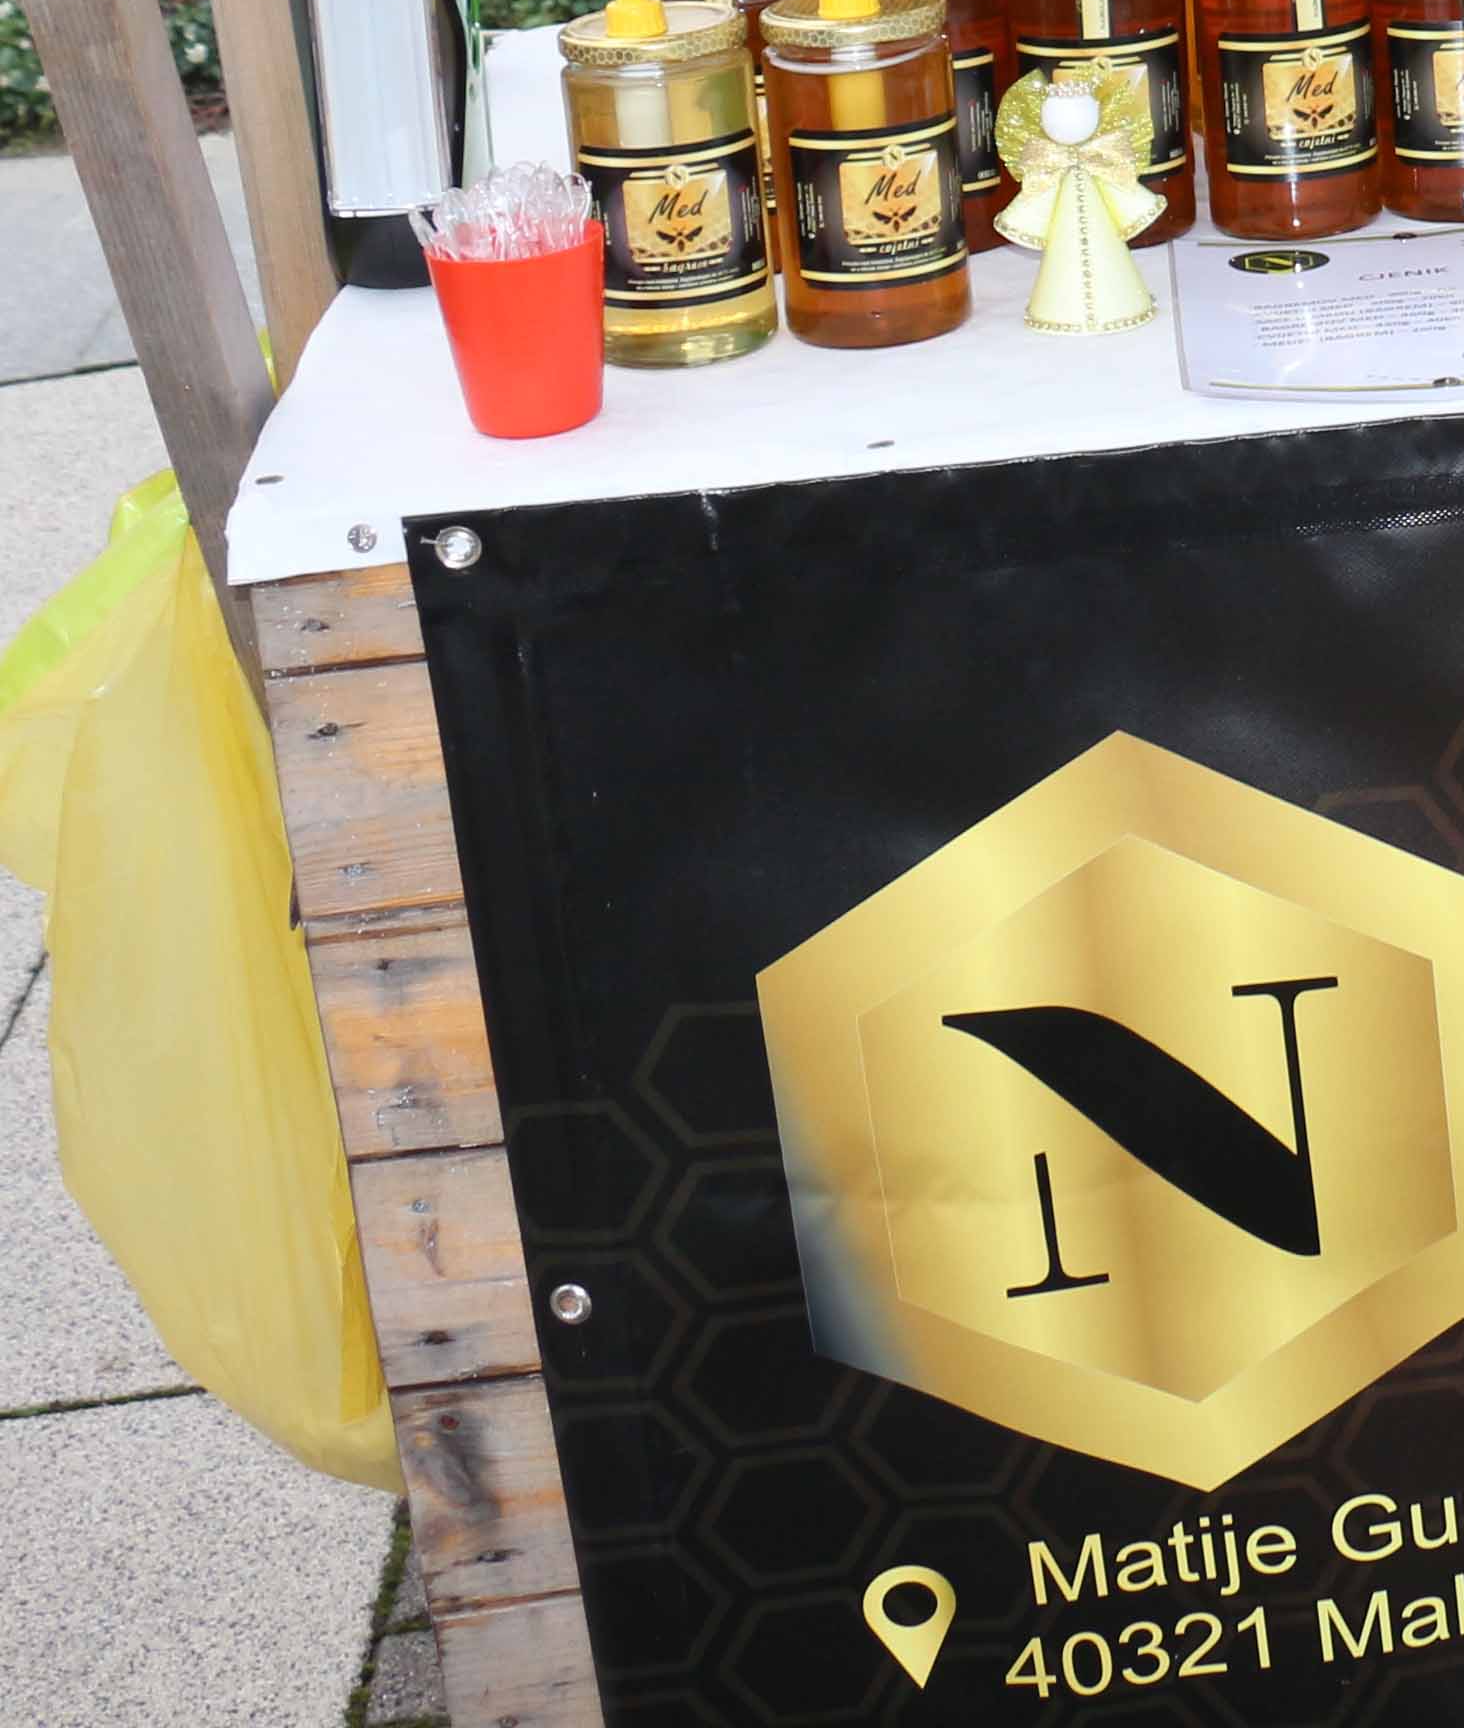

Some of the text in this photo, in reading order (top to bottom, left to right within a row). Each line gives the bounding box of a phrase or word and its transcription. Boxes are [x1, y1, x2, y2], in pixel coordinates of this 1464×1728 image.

[1287, 70, 1336, 101] Med
[647, 189, 709, 225] Med
[864, 171, 919, 205] Med
[940, 975, 1340, 1299] N
[1026, 1512, 1300, 1606] Matije
[1003, 1614, 1278, 1700] 40321
